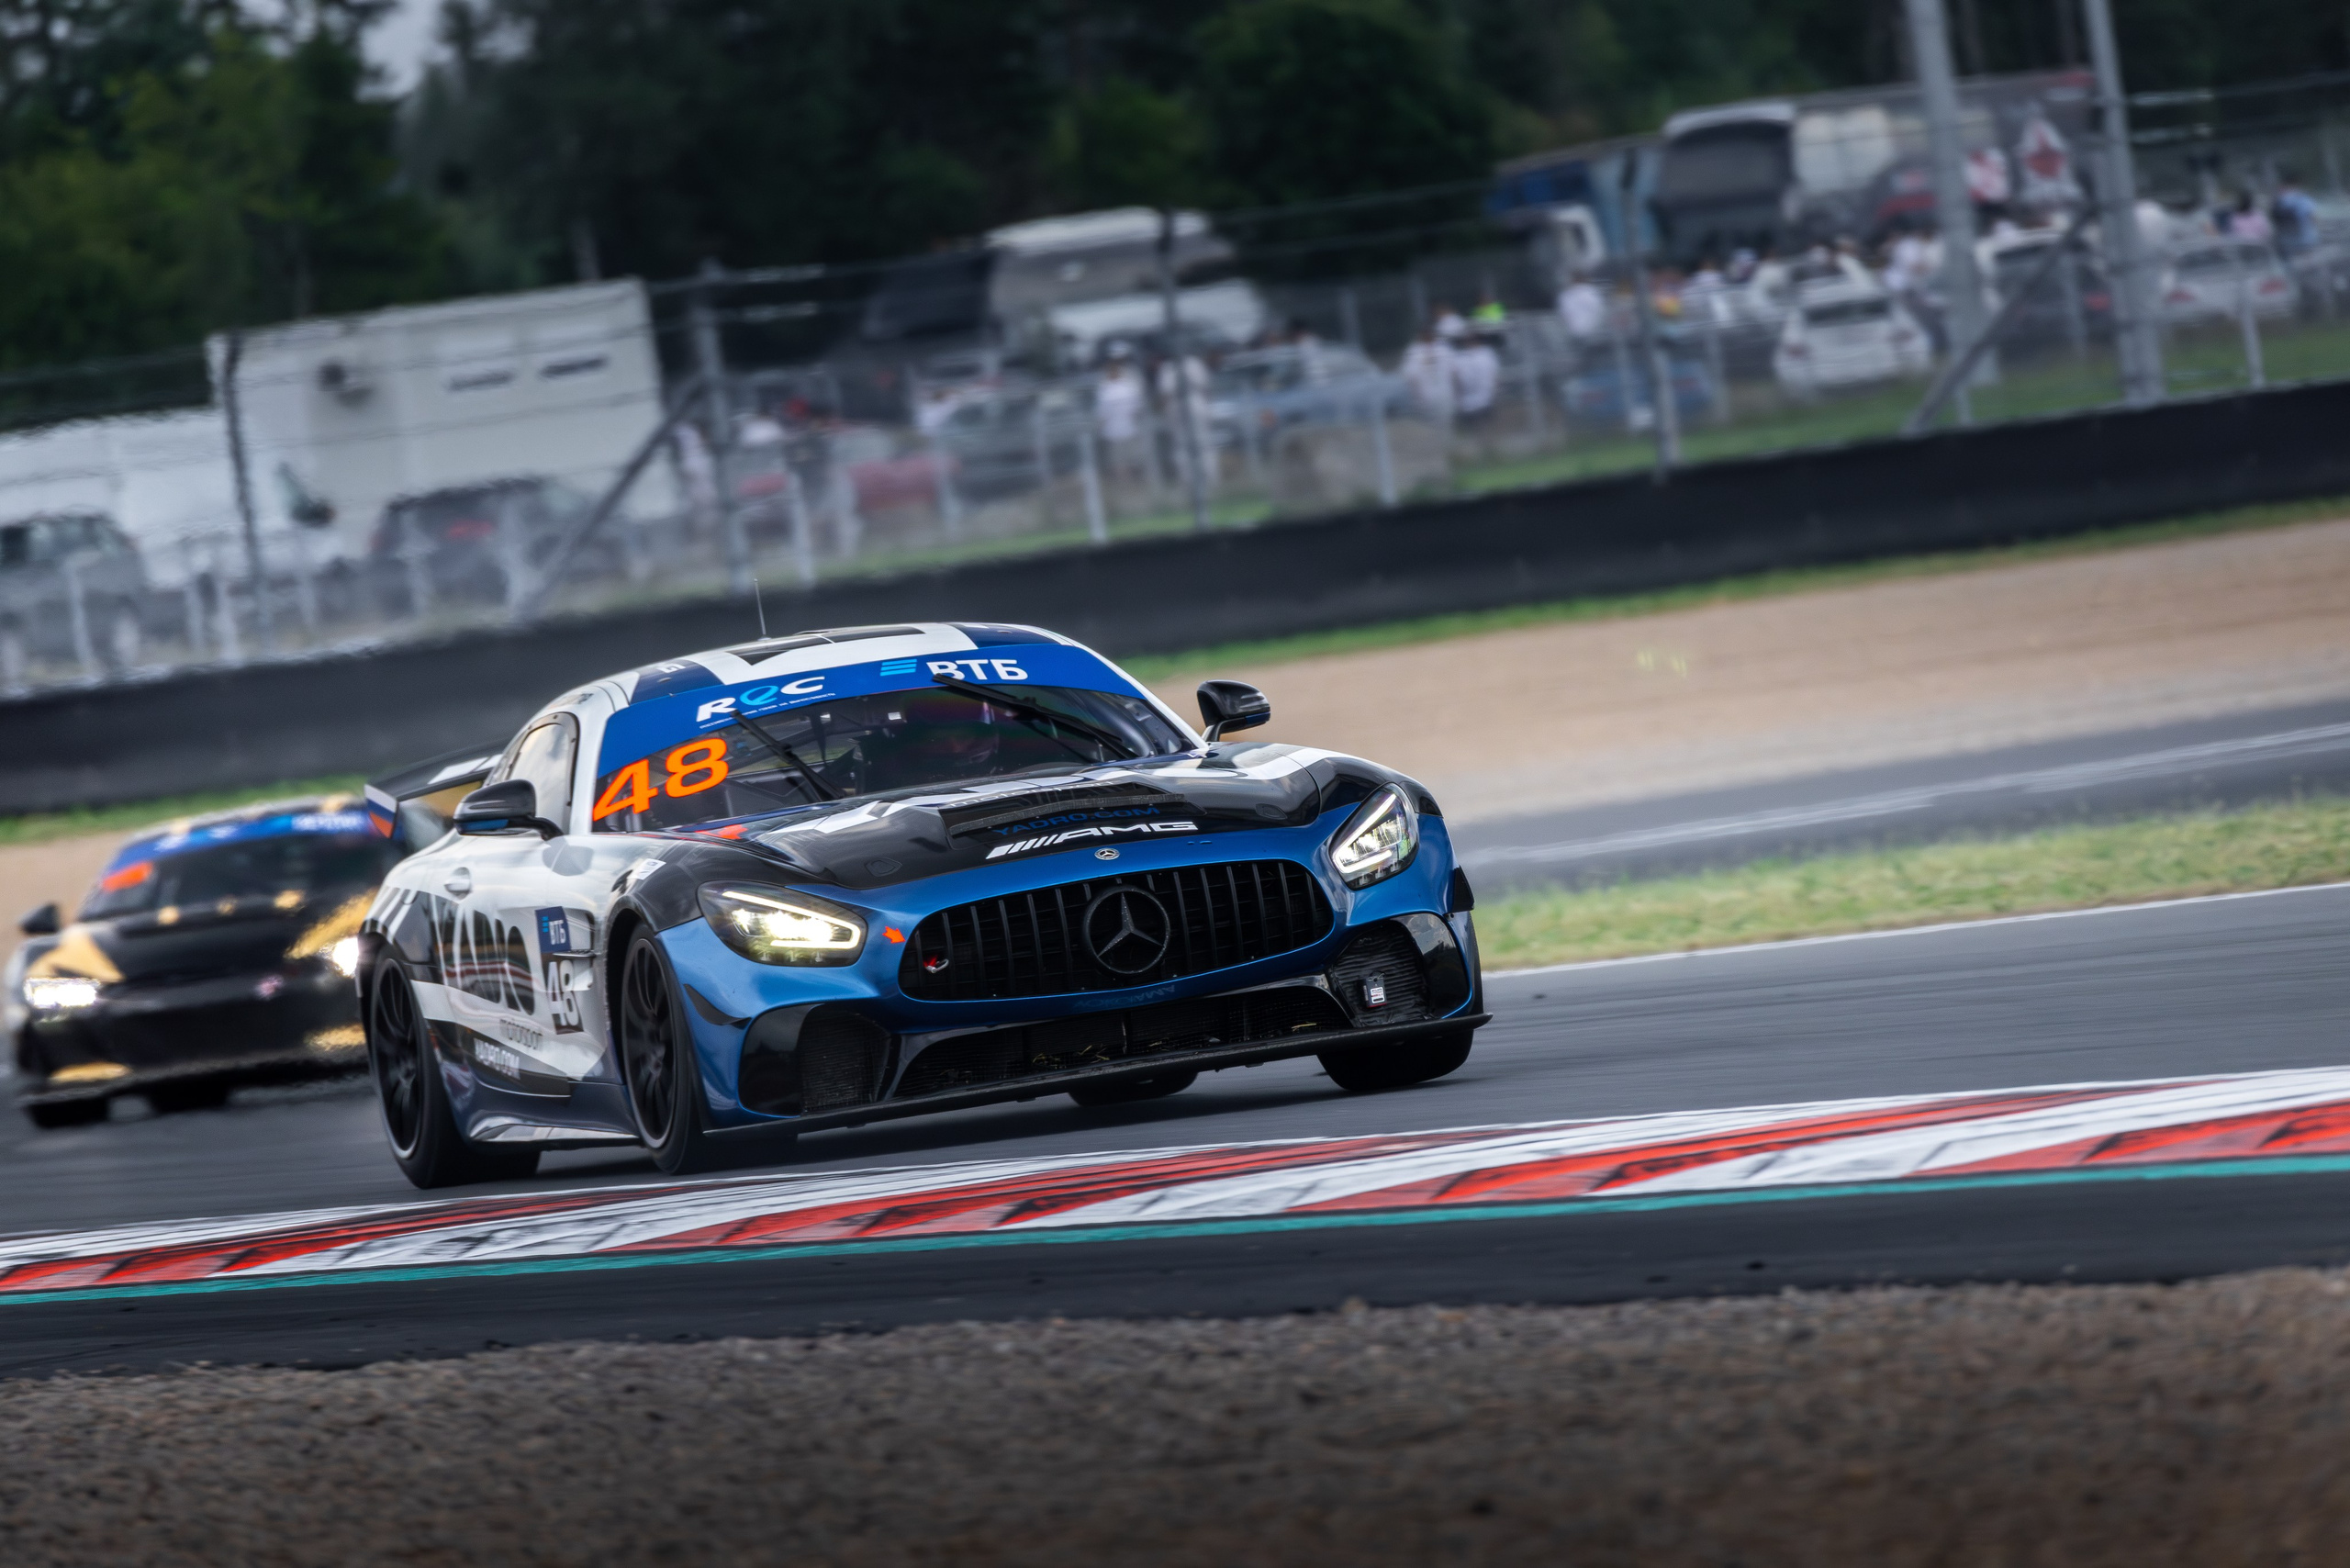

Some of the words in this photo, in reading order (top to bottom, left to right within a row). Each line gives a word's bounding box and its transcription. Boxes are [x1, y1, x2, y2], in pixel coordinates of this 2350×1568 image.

[926, 658, 1029, 681] ВТБ
[592, 737, 730, 822] 48
[992, 806, 1161, 836] YADRO.COM
[1054, 821, 1199, 844] AMG
[547, 959, 579, 1026] 48
